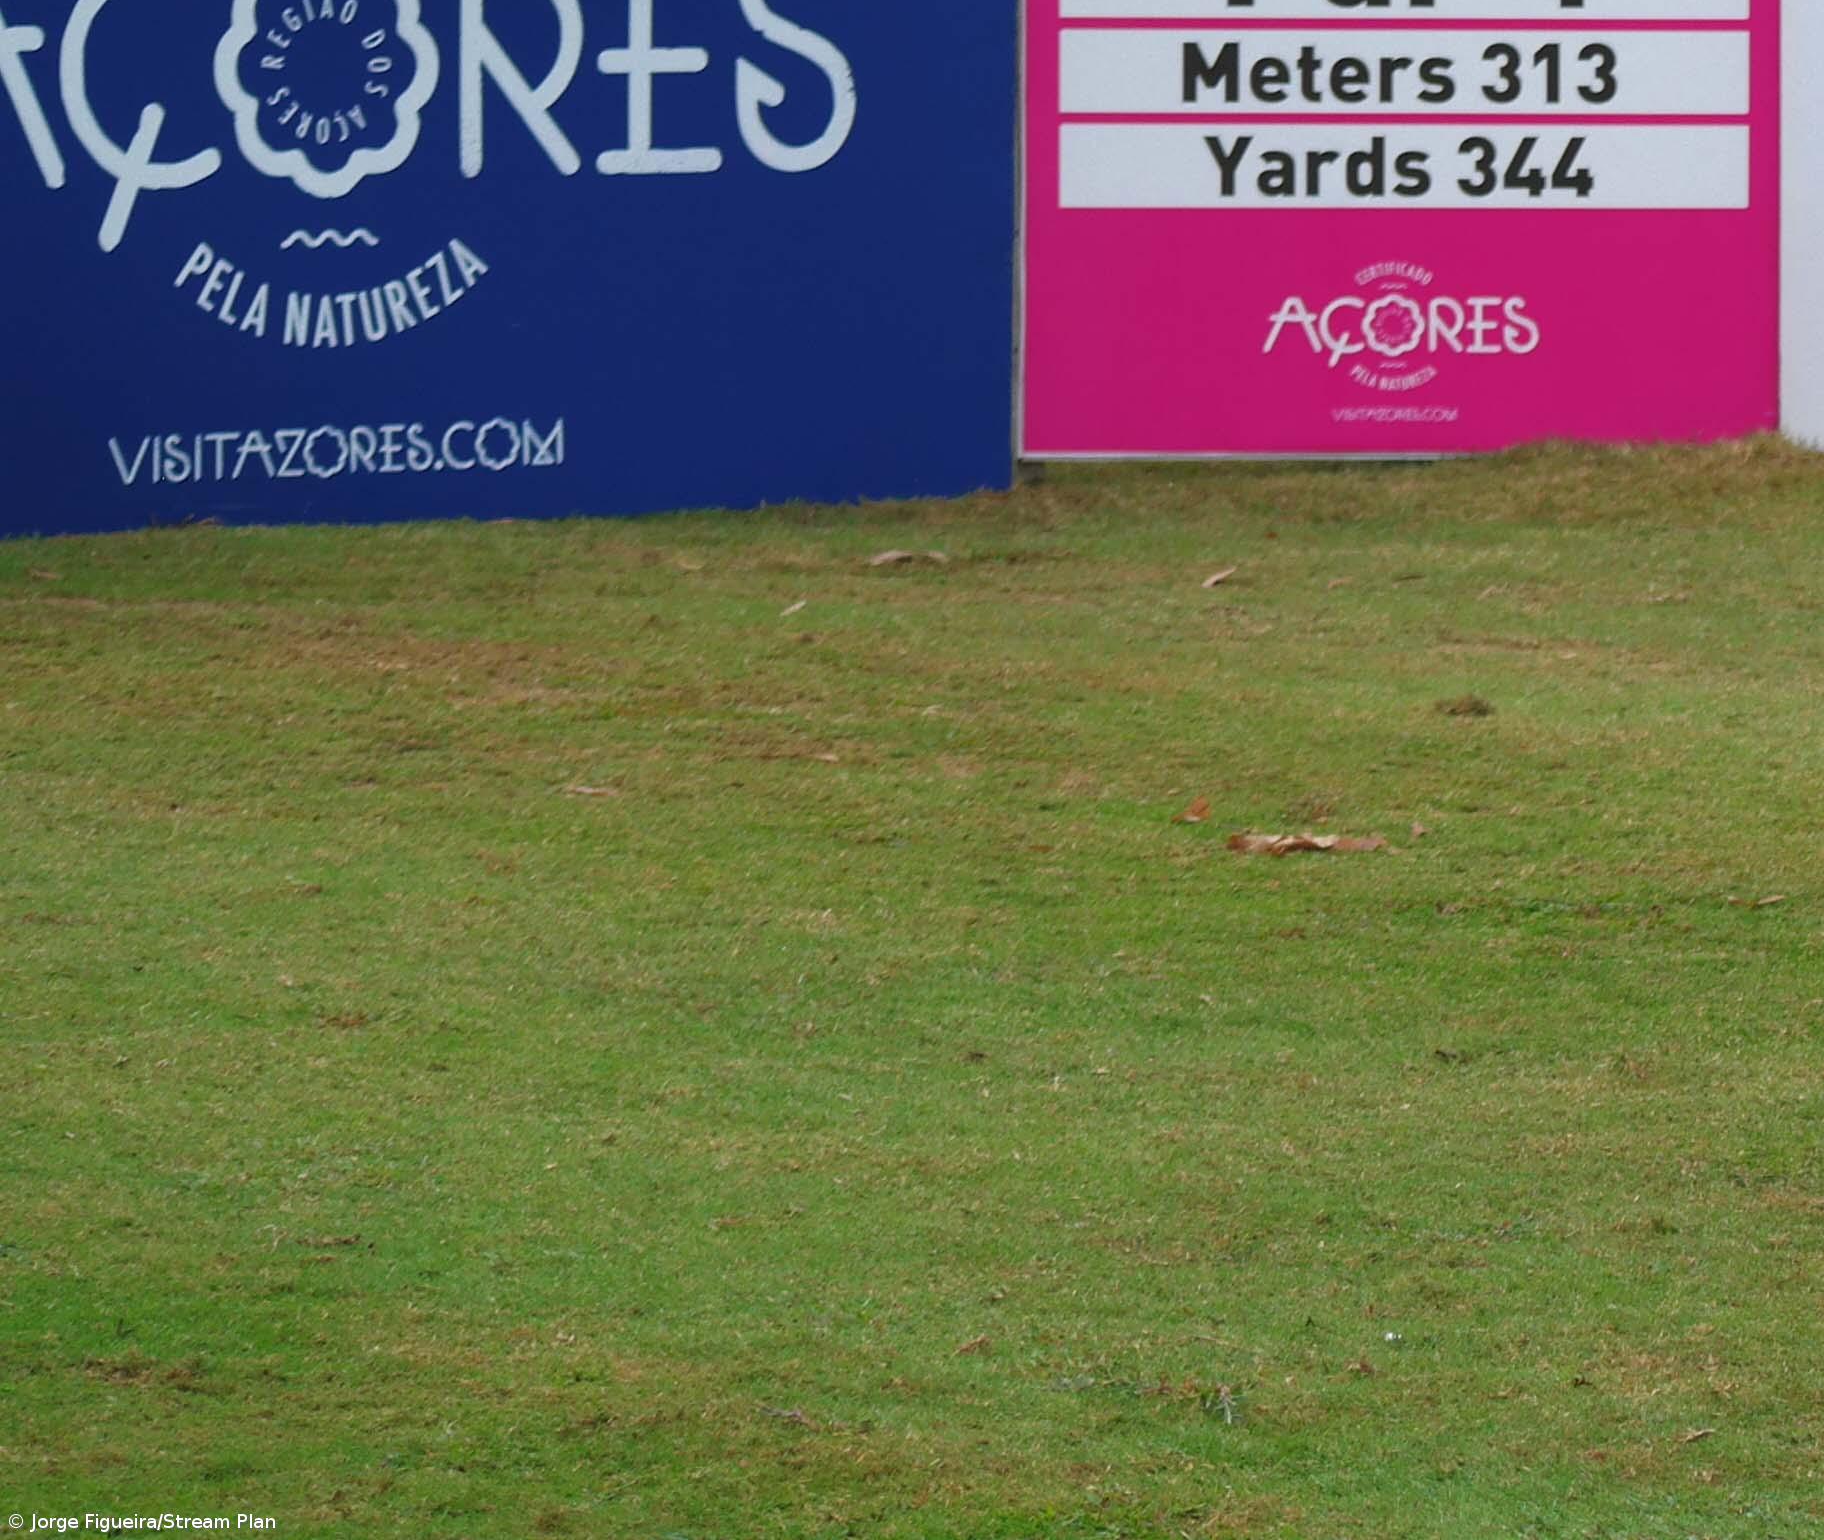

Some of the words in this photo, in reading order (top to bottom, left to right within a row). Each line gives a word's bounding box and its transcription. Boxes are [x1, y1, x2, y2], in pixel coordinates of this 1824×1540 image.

[361, 28, 393, 98] DOS
[1182, 42, 1456, 104] Meters
[1481, 42, 1618, 104] 313
[266, 86, 367, 145] AÇORES
[1204, 136, 1432, 197] Yards
[1457, 136, 1594, 197] 344
[173, 241, 269, 338] PELA
[282, 237, 489, 348] NATUREZA
[1262, 294, 1540, 368] AÇORES
[108, 417, 566, 486] VISITAZORES.COM
